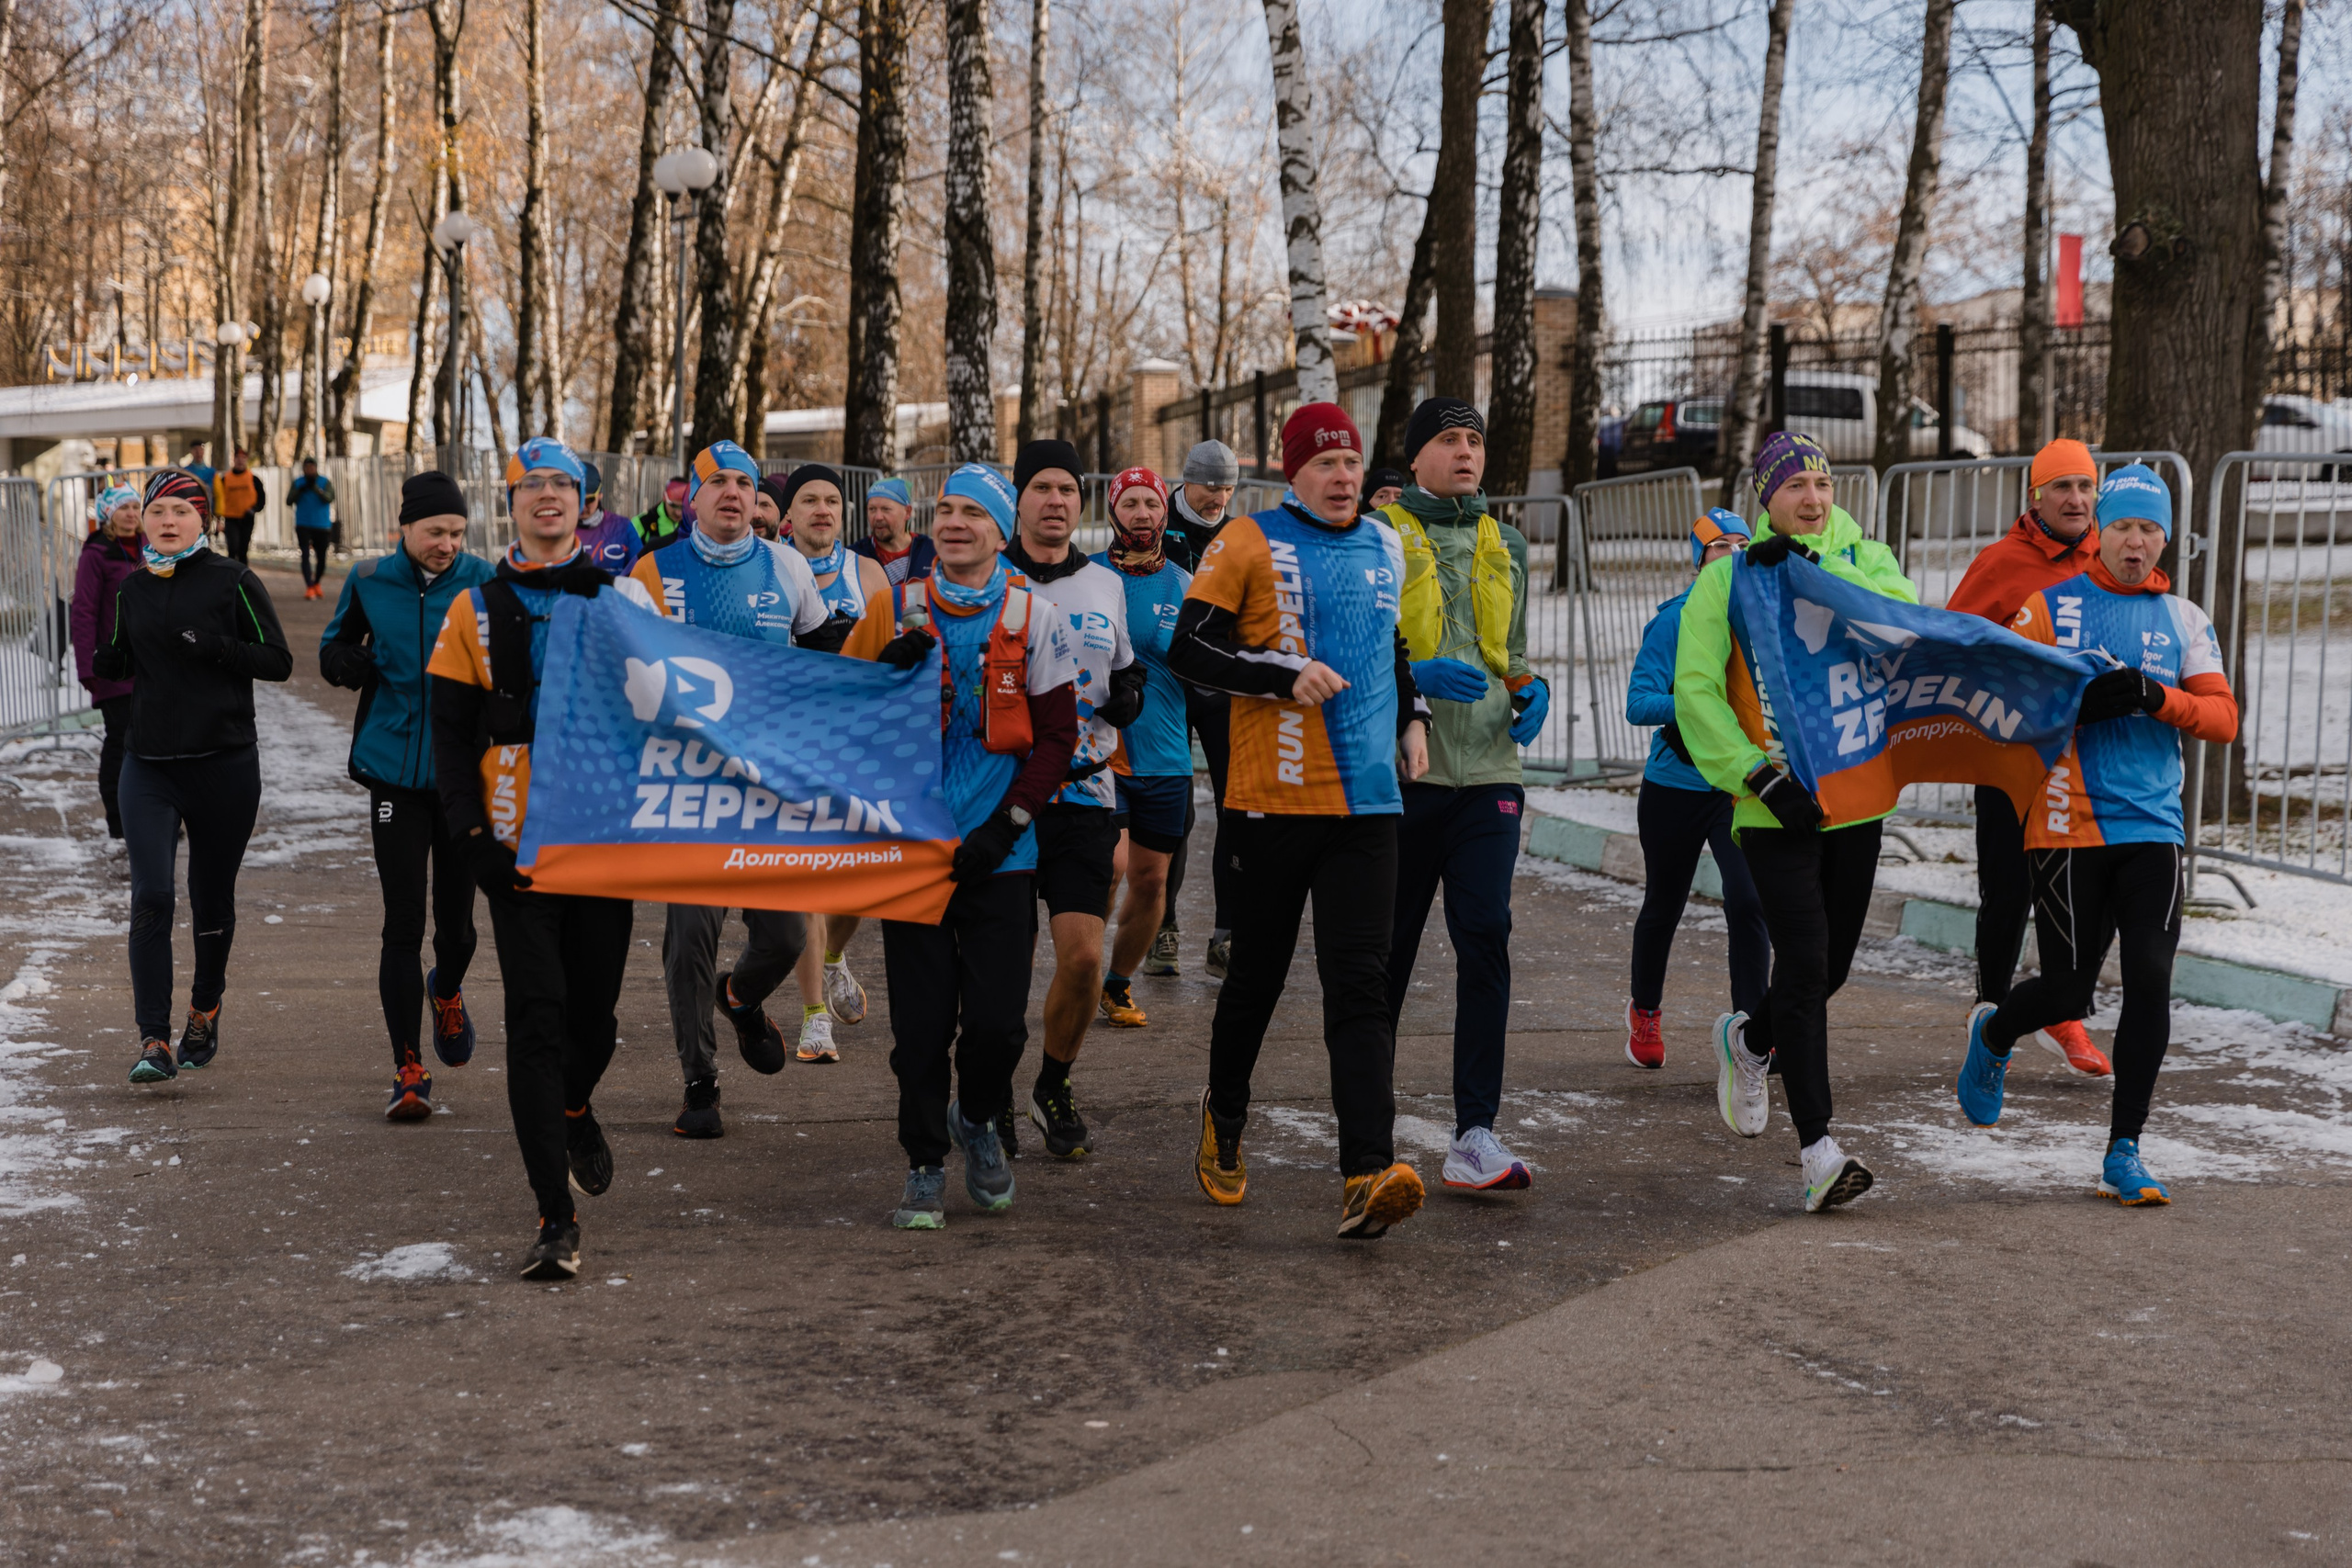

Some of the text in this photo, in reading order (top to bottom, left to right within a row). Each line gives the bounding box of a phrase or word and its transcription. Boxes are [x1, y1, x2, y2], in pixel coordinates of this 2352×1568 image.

[1315, 427, 1350, 447] grom
[984, 473, 1006, 489] RUN
[2114, 482, 2161, 495] ZEPPELIN
[2117, 477, 2139, 485] RUN
[1305, 576, 1314, 594] club
[2143, 649, 2163, 661] Igor
[1278, 708, 1305, 786] RUN
[639, 736, 762, 784] RUN
[492, 774, 516, 843] RUN
[631, 784, 903, 834] ZEPPELIN
[2047, 765, 2070, 835] RUN
[723, 846, 903, 871] Долгопрудный
